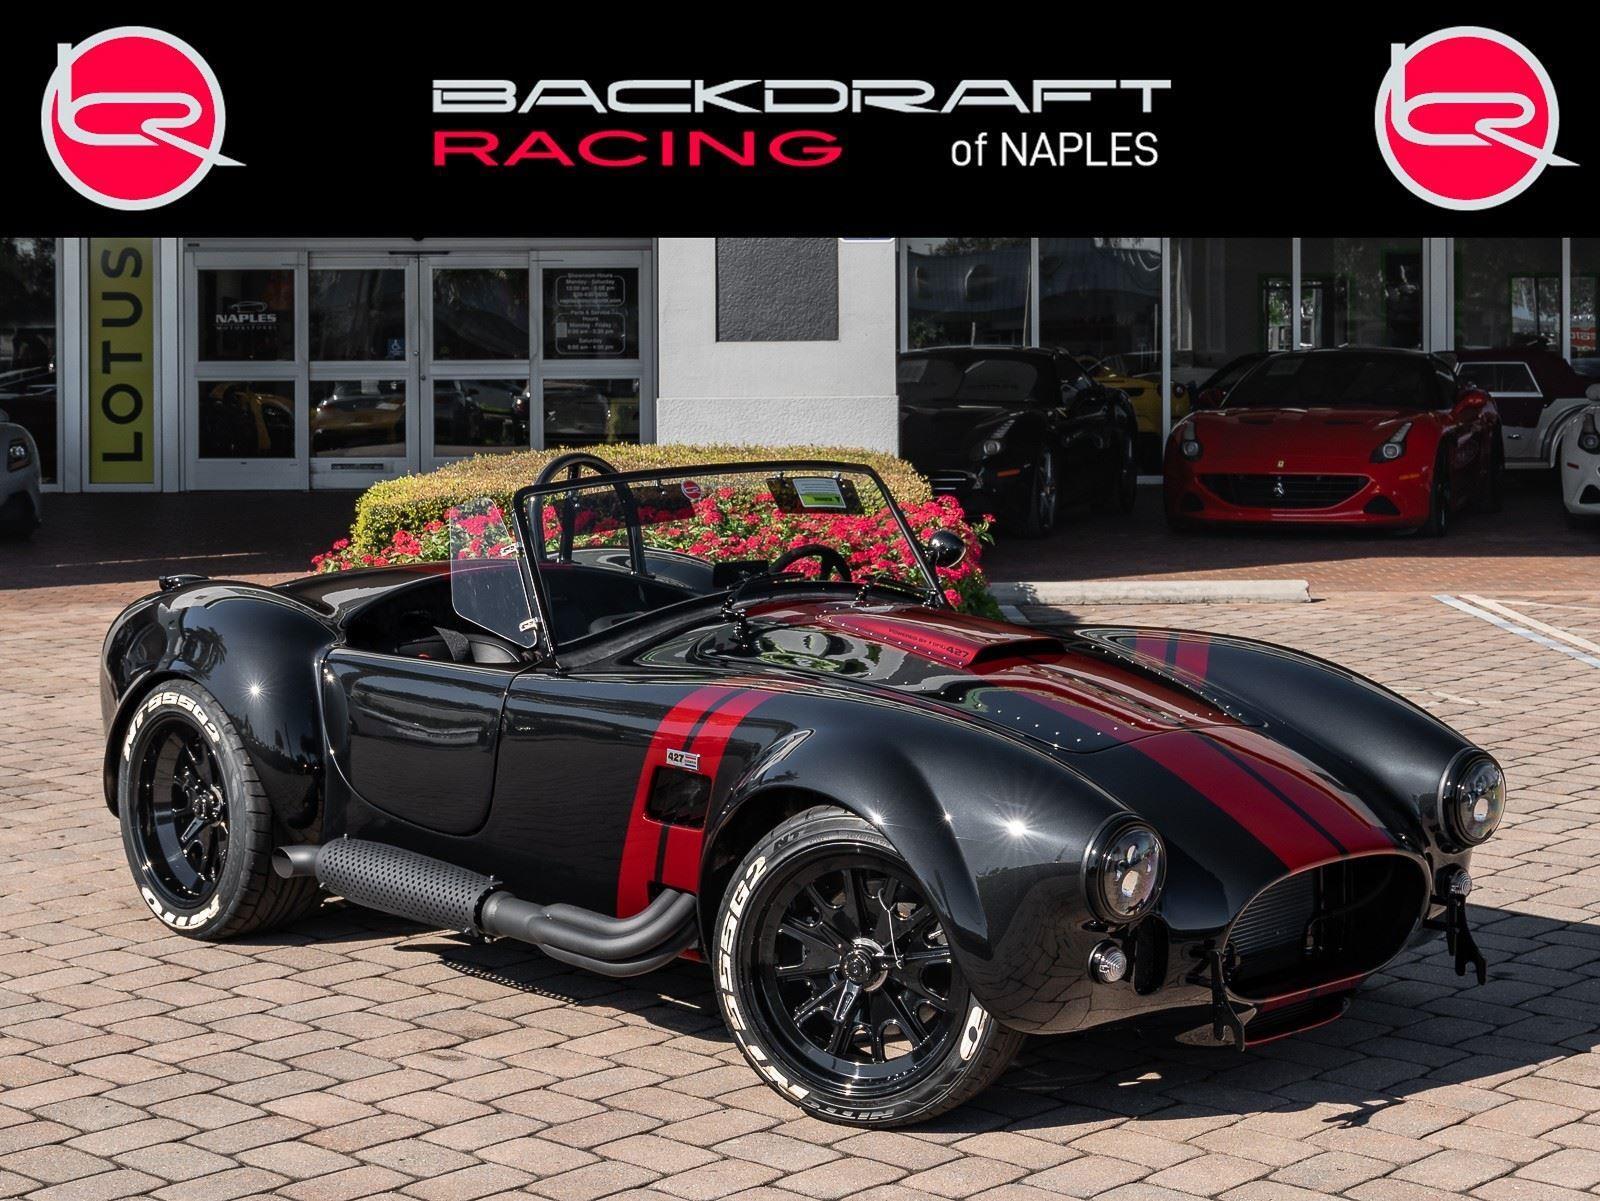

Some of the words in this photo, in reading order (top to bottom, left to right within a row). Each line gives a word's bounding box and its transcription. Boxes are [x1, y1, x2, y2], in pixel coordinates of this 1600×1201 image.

[215, 313, 277, 323] NAPLES
[101, 247, 143, 462] LOTUS
[946, 645, 969, 658] 427
[668, 751, 685, 763] 427
